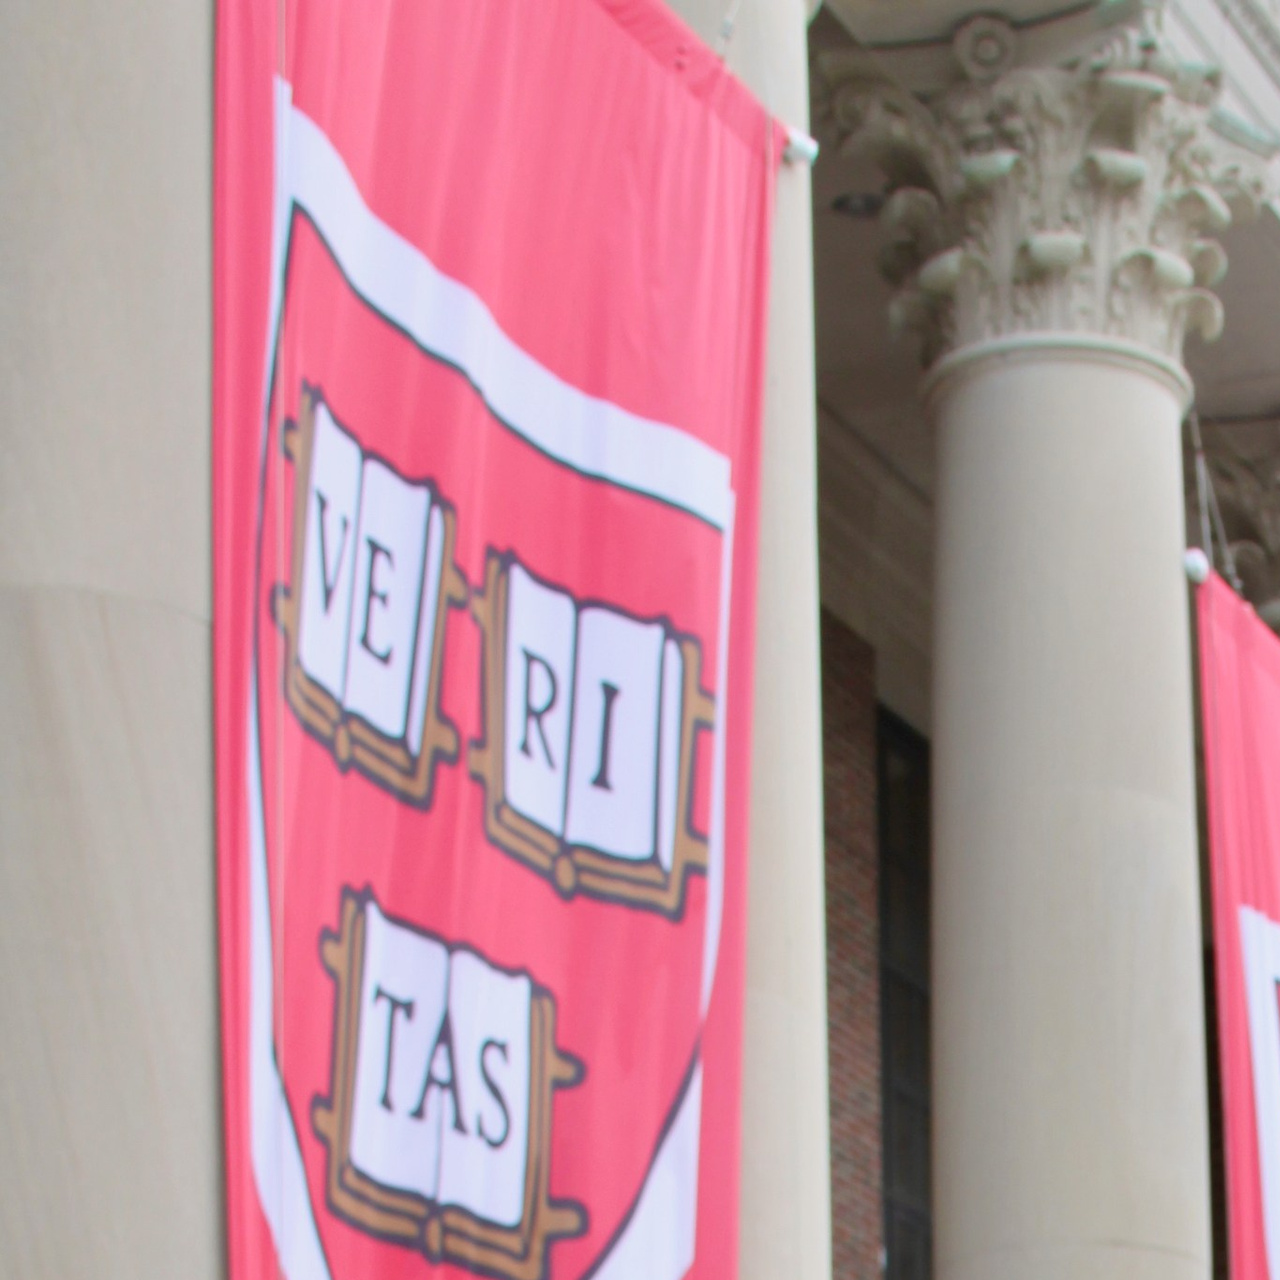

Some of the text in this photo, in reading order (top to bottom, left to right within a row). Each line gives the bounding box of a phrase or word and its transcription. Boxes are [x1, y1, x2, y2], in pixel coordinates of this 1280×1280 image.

[316, 489, 394, 666] VE
[519, 645, 620, 791] RI
[374, 984, 509, 1149] TAS
